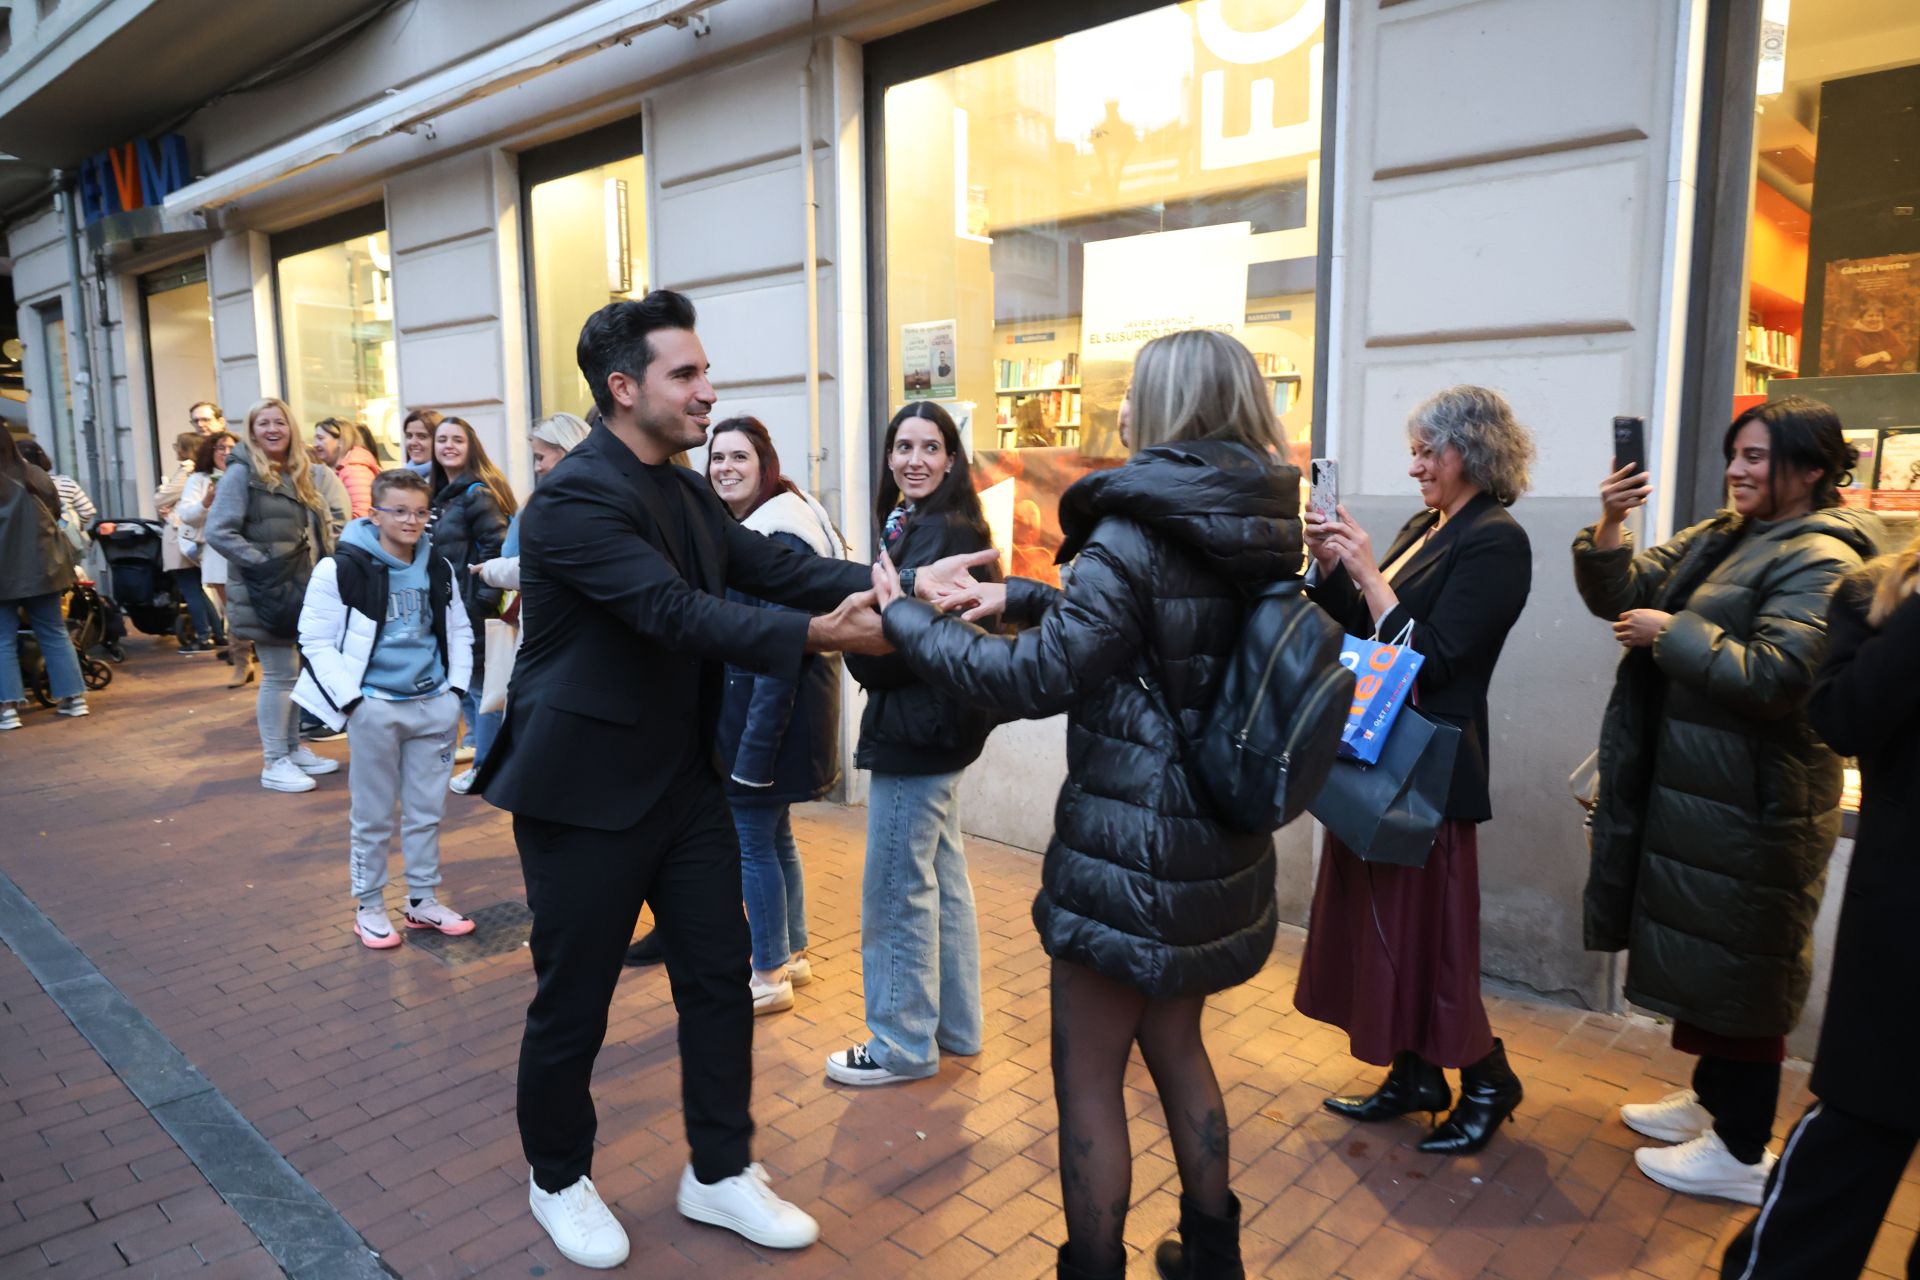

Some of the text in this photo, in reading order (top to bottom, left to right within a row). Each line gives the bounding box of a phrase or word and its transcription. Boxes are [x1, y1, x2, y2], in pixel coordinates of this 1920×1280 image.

[1090, 334, 1102, 344] EL
[1105, 329, 1159, 343] SUSURRO
[1163, 328, 1186, 337] DE
